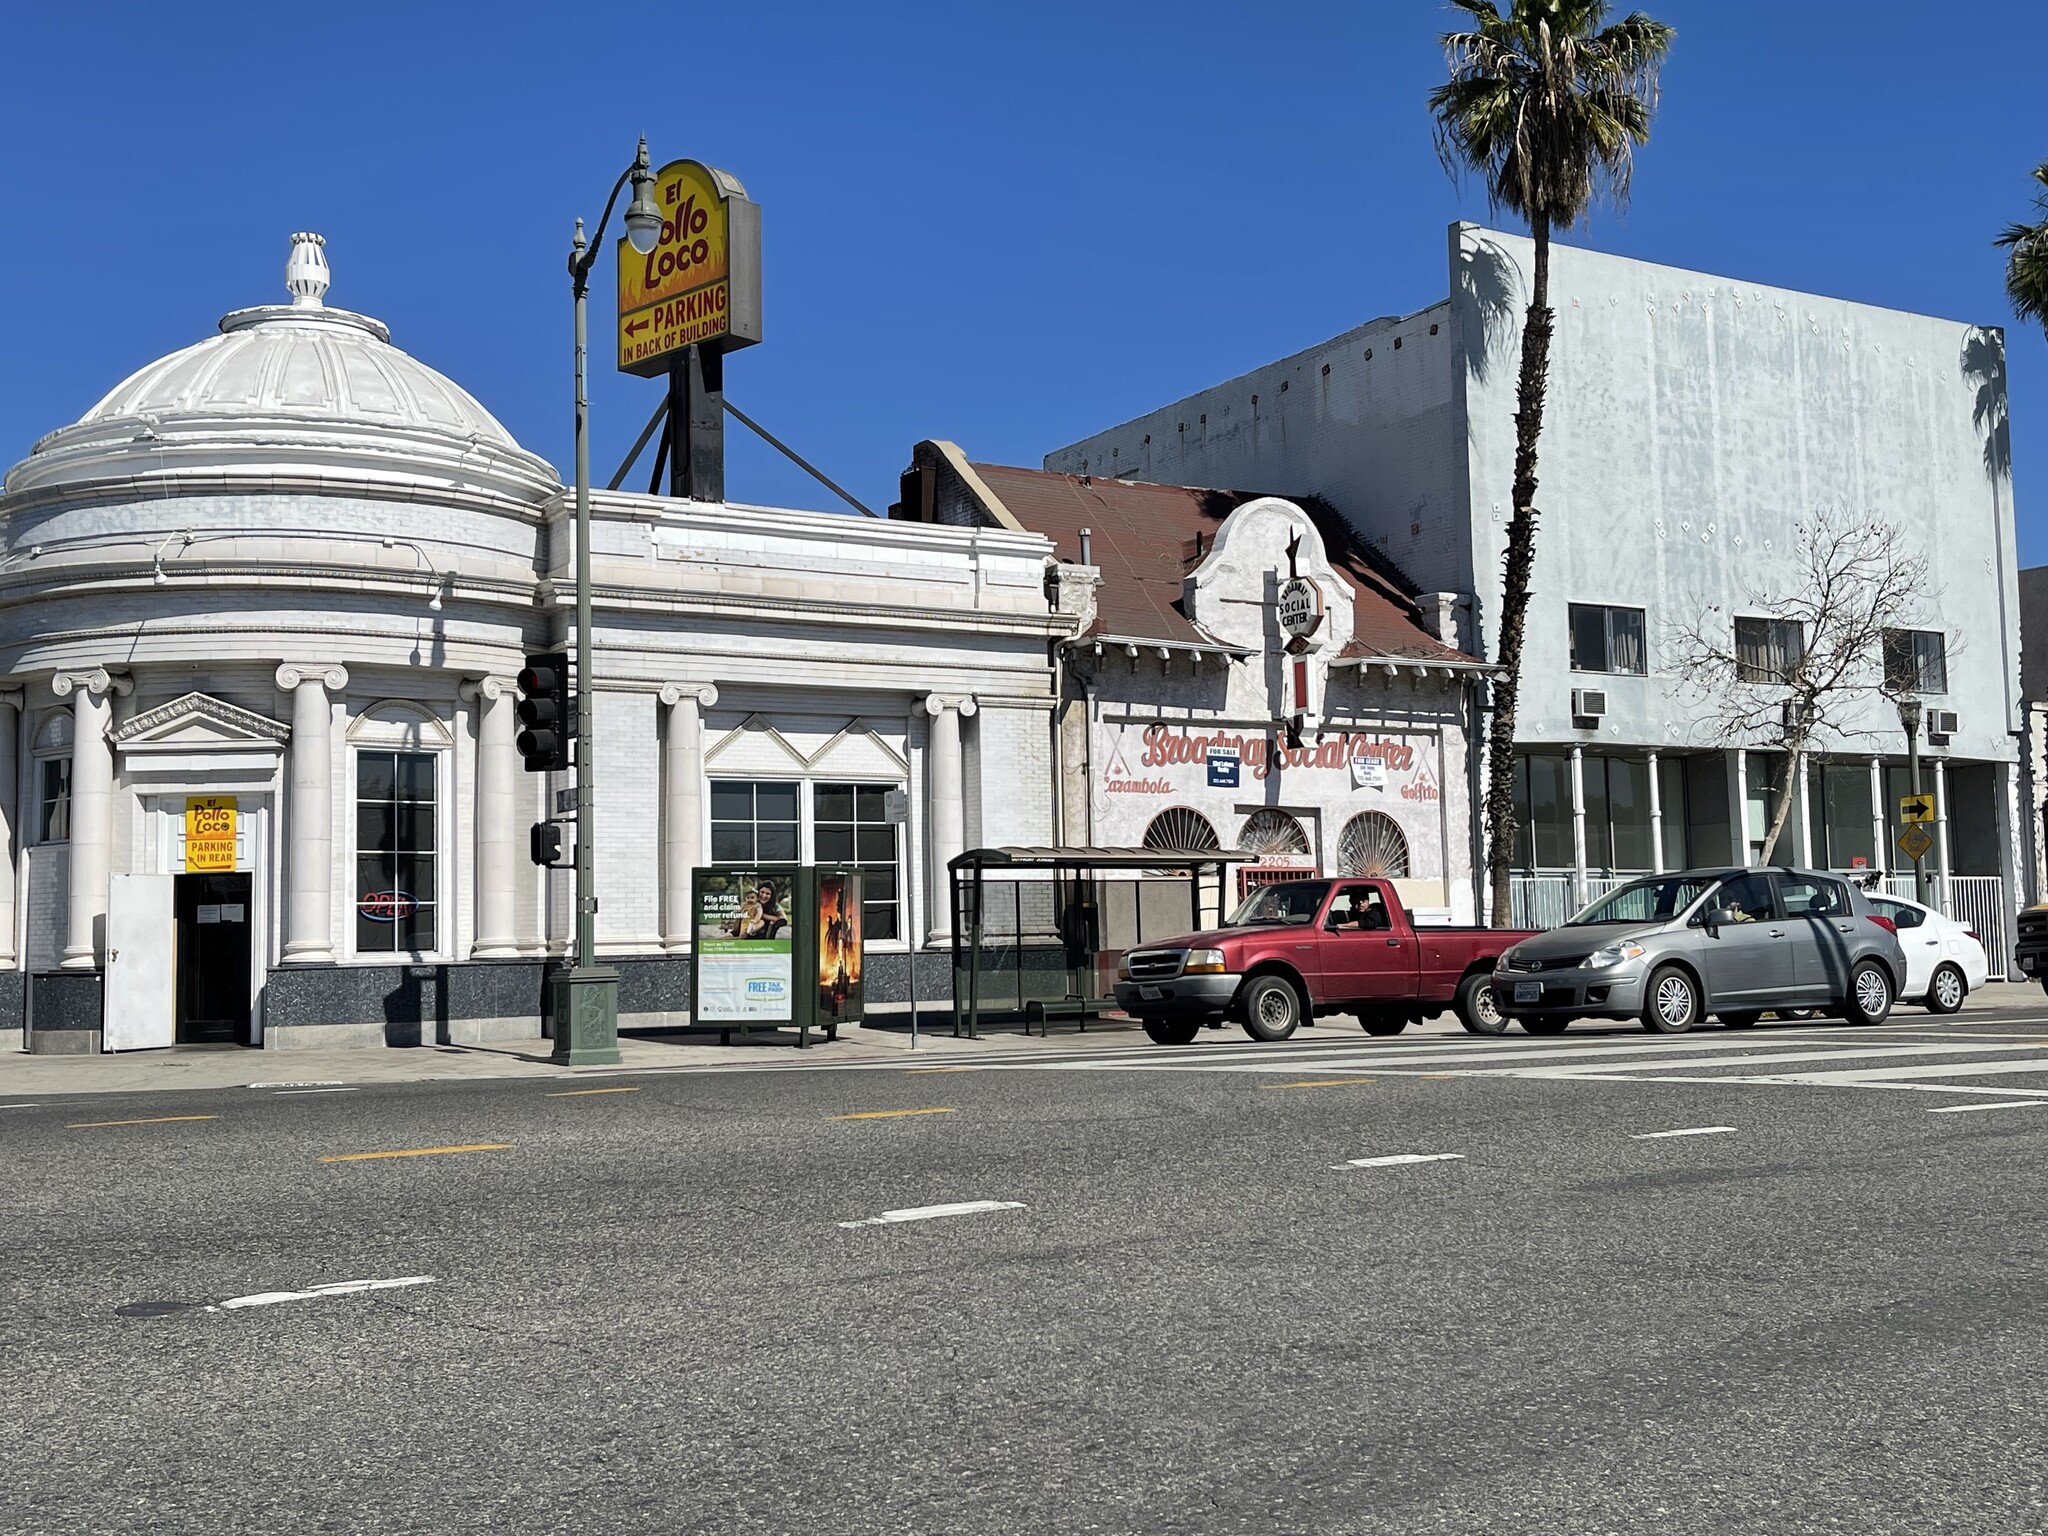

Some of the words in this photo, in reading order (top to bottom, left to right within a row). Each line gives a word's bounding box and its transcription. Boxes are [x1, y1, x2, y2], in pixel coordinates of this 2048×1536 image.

[665, 178, 682, 205] El
[658, 194, 708, 246] ollo
[645, 239, 709, 289] Loco
[654, 285, 726, 333] PARKING
[623, 346, 633, 363] IN
[636, 336, 661, 359] BACK
[664, 331, 677, 349] OF
[680, 315, 726, 343] BUILDING
[1279, 598, 1311, 614] SOCIAL
[1282, 612, 1308, 627] CENTER
[1401, 783, 1438, 803] Golfito
[207, 799, 217, 807] El
[194, 804, 230, 821] Pollo
[195, 819, 230, 834] Loco
[191, 842, 233, 852] PARKING
[197, 854, 206, 862] IN
[209, 854, 232, 862] REAR
[1260, 856, 1290, 868] 2205
[719, 895, 739, 903] FREE
[703, 903, 719, 911] and
[719, 903, 741, 911] claim
[703, 912, 721, 920] your
[722, 911, 751, 919] refund.
[748, 982, 767, 993] FREE
